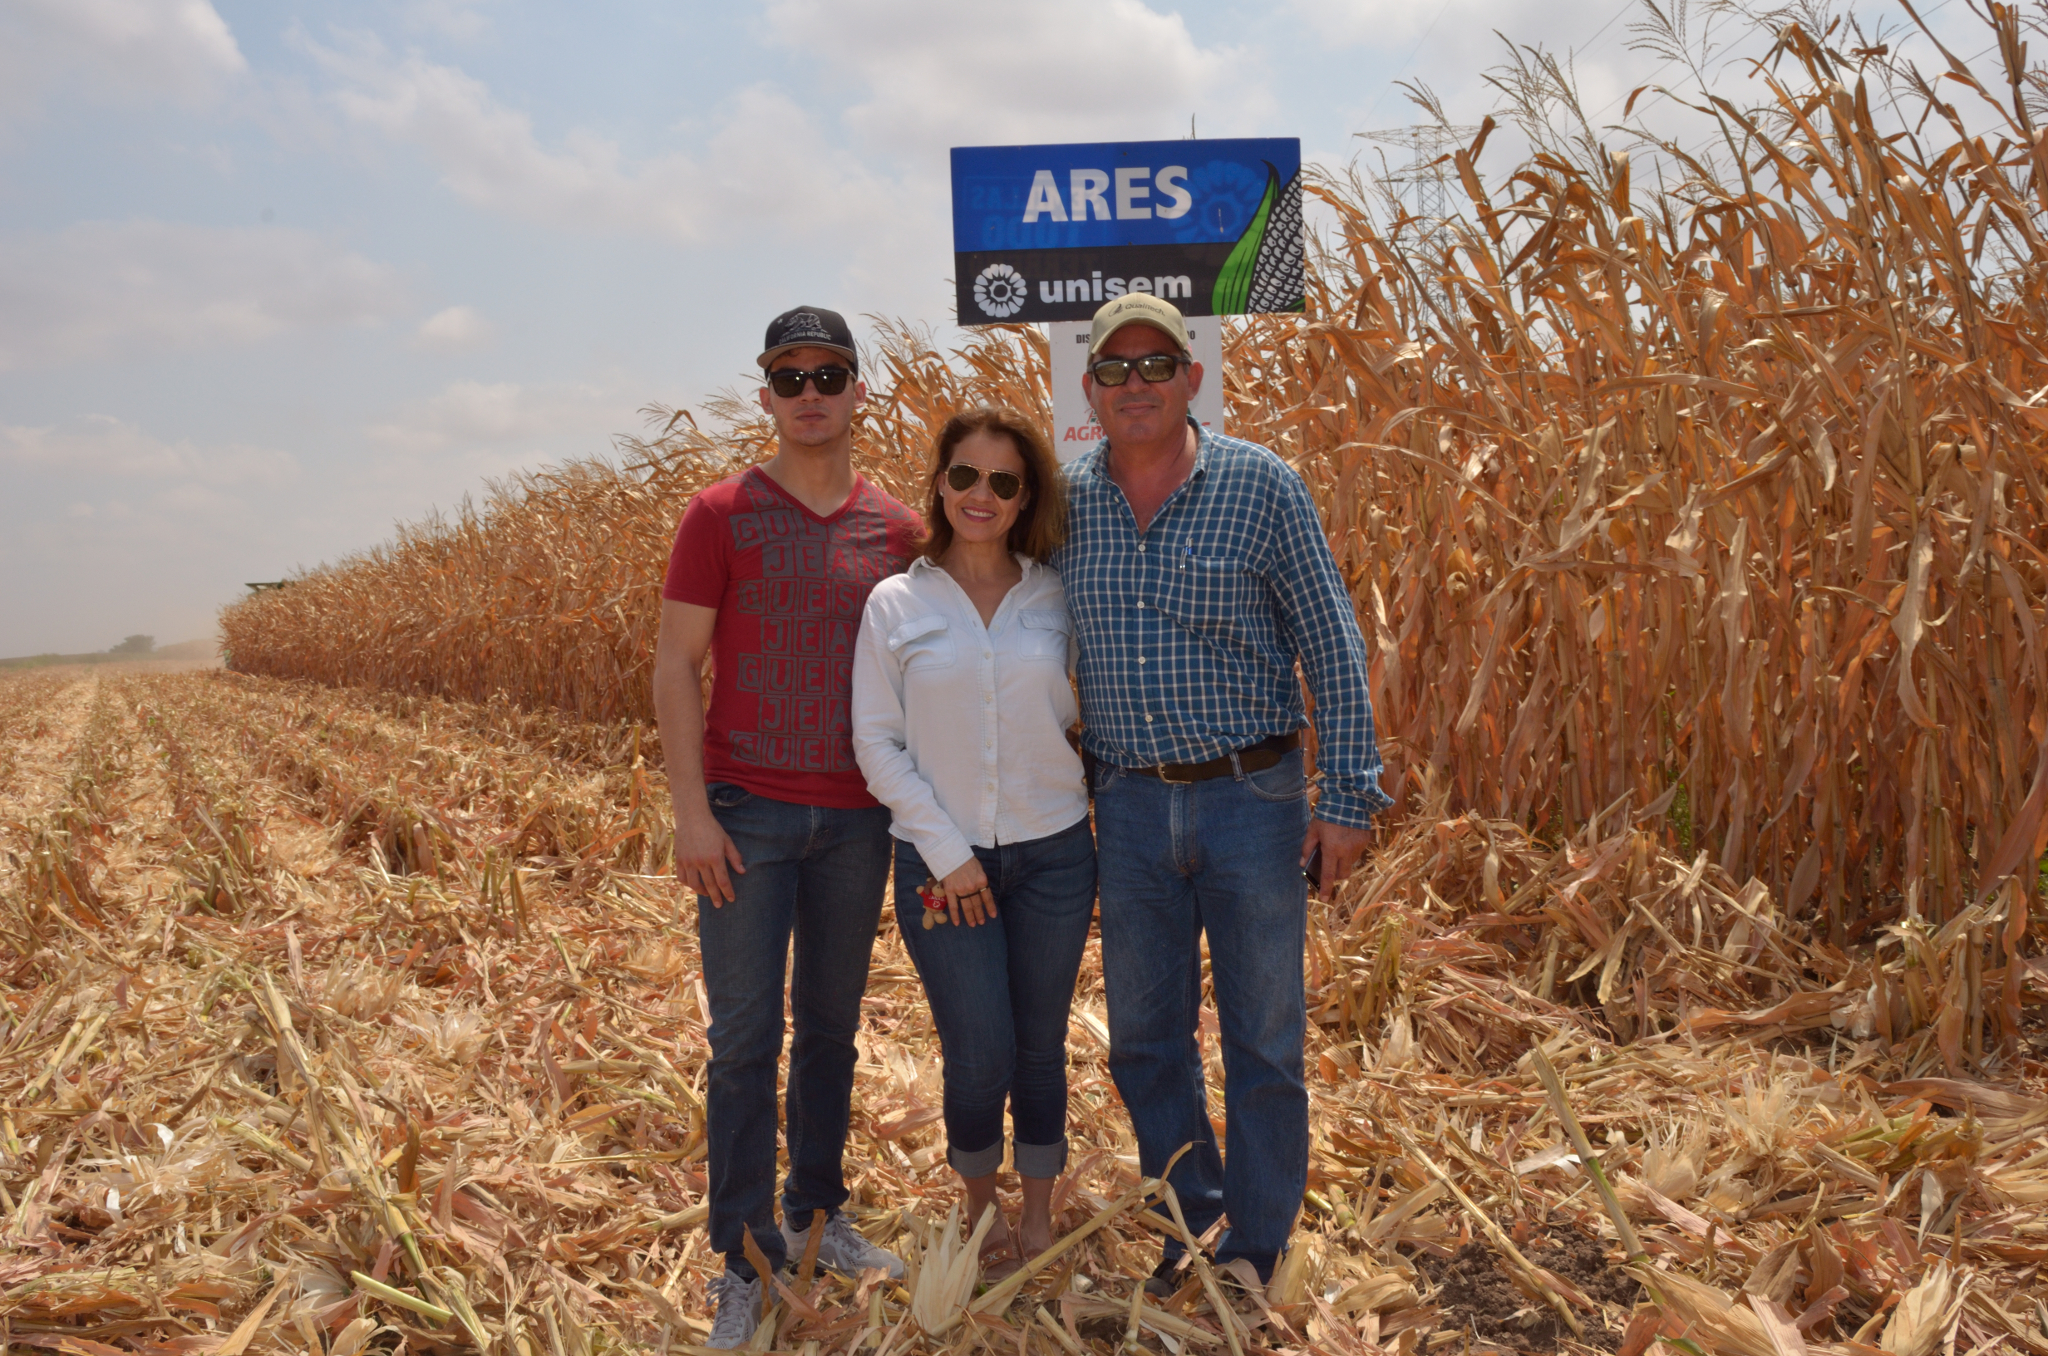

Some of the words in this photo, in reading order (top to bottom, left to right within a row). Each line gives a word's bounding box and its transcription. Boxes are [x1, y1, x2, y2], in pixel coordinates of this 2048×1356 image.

[1022, 165, 1192, 223] ARES
[1039, 271, 1192, 303] unisem
[807, 331, 832, 341] REPUBLIC
[1076, 333, 1091, 344] DIS
[1063, 425, 1106, 442] AGR
[737, 513, 882, 546] GUESS
[741, 581, 856, 616] GUES
[766, 620, 850, 653] JEA
[741, 657, 852, 692] GUES
[764, 699, 849, 730] JEA
[733, 735, 852, 768] GUES
